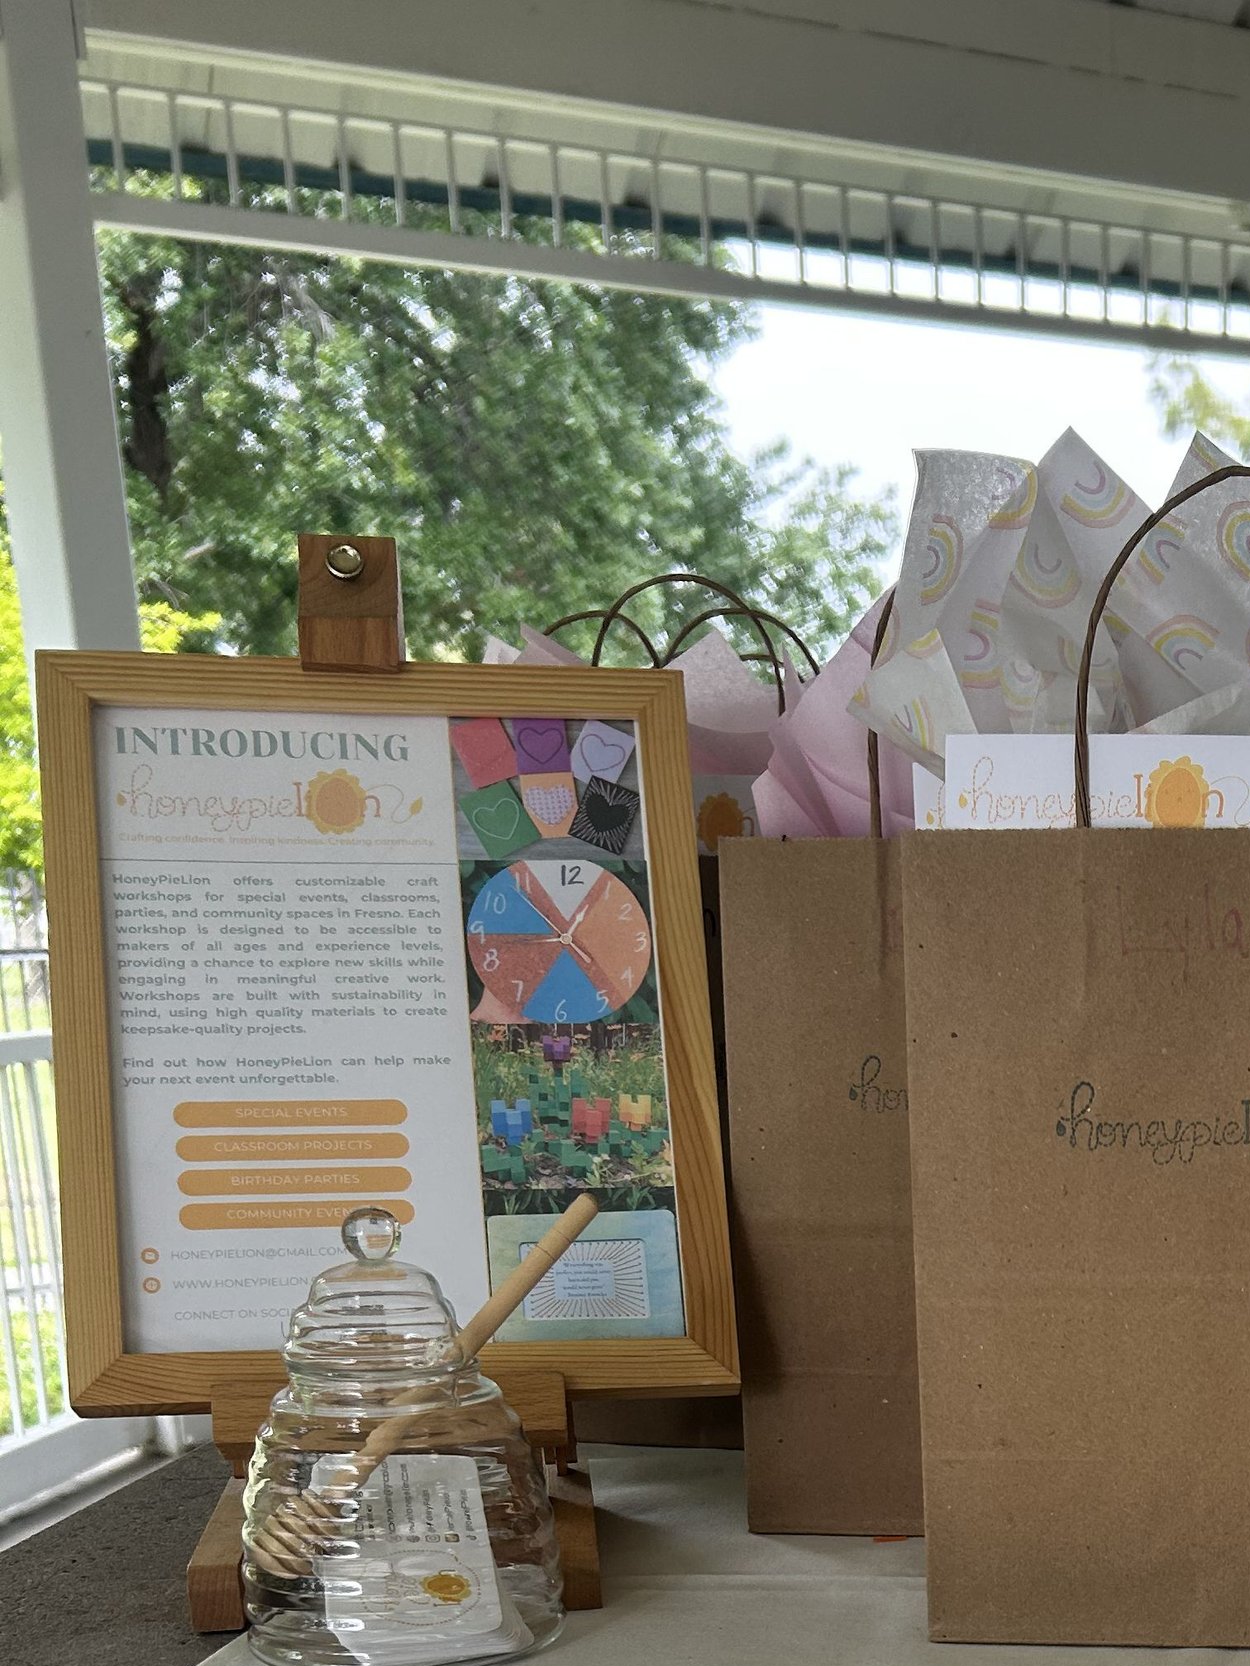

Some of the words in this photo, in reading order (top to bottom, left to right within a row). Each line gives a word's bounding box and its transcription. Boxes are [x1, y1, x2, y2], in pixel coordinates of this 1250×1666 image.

[114, 726, 409, 761] INTRODUCING
[966, 756, 1224, 829] honeyielion
[112, 873, 211, 887] HoneyPieLion
[233, 876, 273, 887] offers
[295, 875, 386, 887] customizable
[407, 876, 439, 887] craft
[561, 864, 584, 886] 12
[113, 891, 192, 904] workshops
[204, 891, 224, 902] for
[237, 892, 286, 904] special
[299, 893, 348, 904] events,
[361, 892, 440, 904] classrooms,
[483, 890, 507, 915] 10
[114, 907, 168, 920] parties,
[172, 908, 198, 919] and
[202, 908, 281, 921] community
[286, 909, 334, 921] spaces
[337, 908, 350, 919] in
[354, 909, 404, 919] Fresno.
[408, 909, 441, 919] Each
[619, 903, 633, 921] 2
[115, 924, 187, 937] workshop
[197, 924, 209, 935] is
[220, 924, 284, 937] designed
[295, 925, 309, 935] to
[320, 924, 337, 935] be
[347, 924, 417, 936] accessible
[427, 925, 442, 936] to
[468, 920, 486, 945] 9
[116, 940, 170, 952] makers
[181, 940, 195, 952] of
[206, 940, 222, 952] all
[233, 942, 267, 954] ages
[278, 940, 304, 952] and
[315, 940, 390, 954] experience
[400, 940, 443, 953] levels,
[634, 931, 647, 953] 3
[117, 956, 186, 970] providing
[190, 958, 199, 968] a
[203, 957, 255, 969] chance
[259, 957, 274, 969] to
[278, 957, 331, 971] explore
[334, 957, 365, 968] new
[368, 956, 403, 968] skills
[408, 956, 445, 968] while
[482, 948, 500, 972] 8
[118, 974, 186, 987] engaging
[204, 973, 218, 985] in
[236, 973, 316, 986] meaningful
[334, 973, 390, 985] creative
[407, 973, 446, 984] work.
[620, 965, 634, 989] 4
[119, 990, 201, 1004] Workshops
[211, 991, 234, 1002] are
[246, 990, 278, 1001] built
[289, 990, 320, 1001] with
[330, 989, 423, 1003] sustainability
[433, 989, 446, 1001] in
[511, 980, 524, 1003] 7
[596, 990, 609, 1013] 5
[120, 1006, 161, 1020] mind,
[168, 1007, 208, 1020] using
[215, 1006, 248, 1020] high
[255, 1006, 303, 1020] quality
[311, 1005, 376, 1018] materials
[383, 1006, 397, 1017] to
[404, 1006, 448, 1018] create
[554, 999, 568, 1022] 6
[120, 1023, 243, 1037] keepsake-quality
[246, 1022, 307, 1037] projects.
[122, 1058, 154, 1069] Find
[163, 1058, 188, 1069] out
[196, 1057, 227, 1069] how
[235, 1056, 333, 1070] HoneyPieLion
[341, 1057, 366, 1068] can
[374, 1055, 405, 1069] help
[412, 1055, 451, 1066] make
[123, 1074, 156, 1087] your
[160, 1074, 192, 1085] next
[195, 1074, 236, 1085] event
[239, 1072, 340, 1087] unforgettable.
[235, 1107, 292, 1119] SPECIAL
[296, 1106, 348, 1118] EVENTS
[213, 1140, 300, 1152] CLASSROOM
[303, 1139, 372, 1152] PROJECTS
[230, 1174, 300, 1187] BIRTHDAY
[304, 1173, 360, 1185] PARTIES
[226, 1207, 313, 1220] COMMUNITY
[317, 1207, 352, 1218] EVEN
[172, 1275, 316, 1289] WWW.HONEYPIELION.
[174, 1309, 235, 1321] CONNECT
[240, 1308, 261, 1320] ON
[261, 1307, 293, 1319] SOCI
